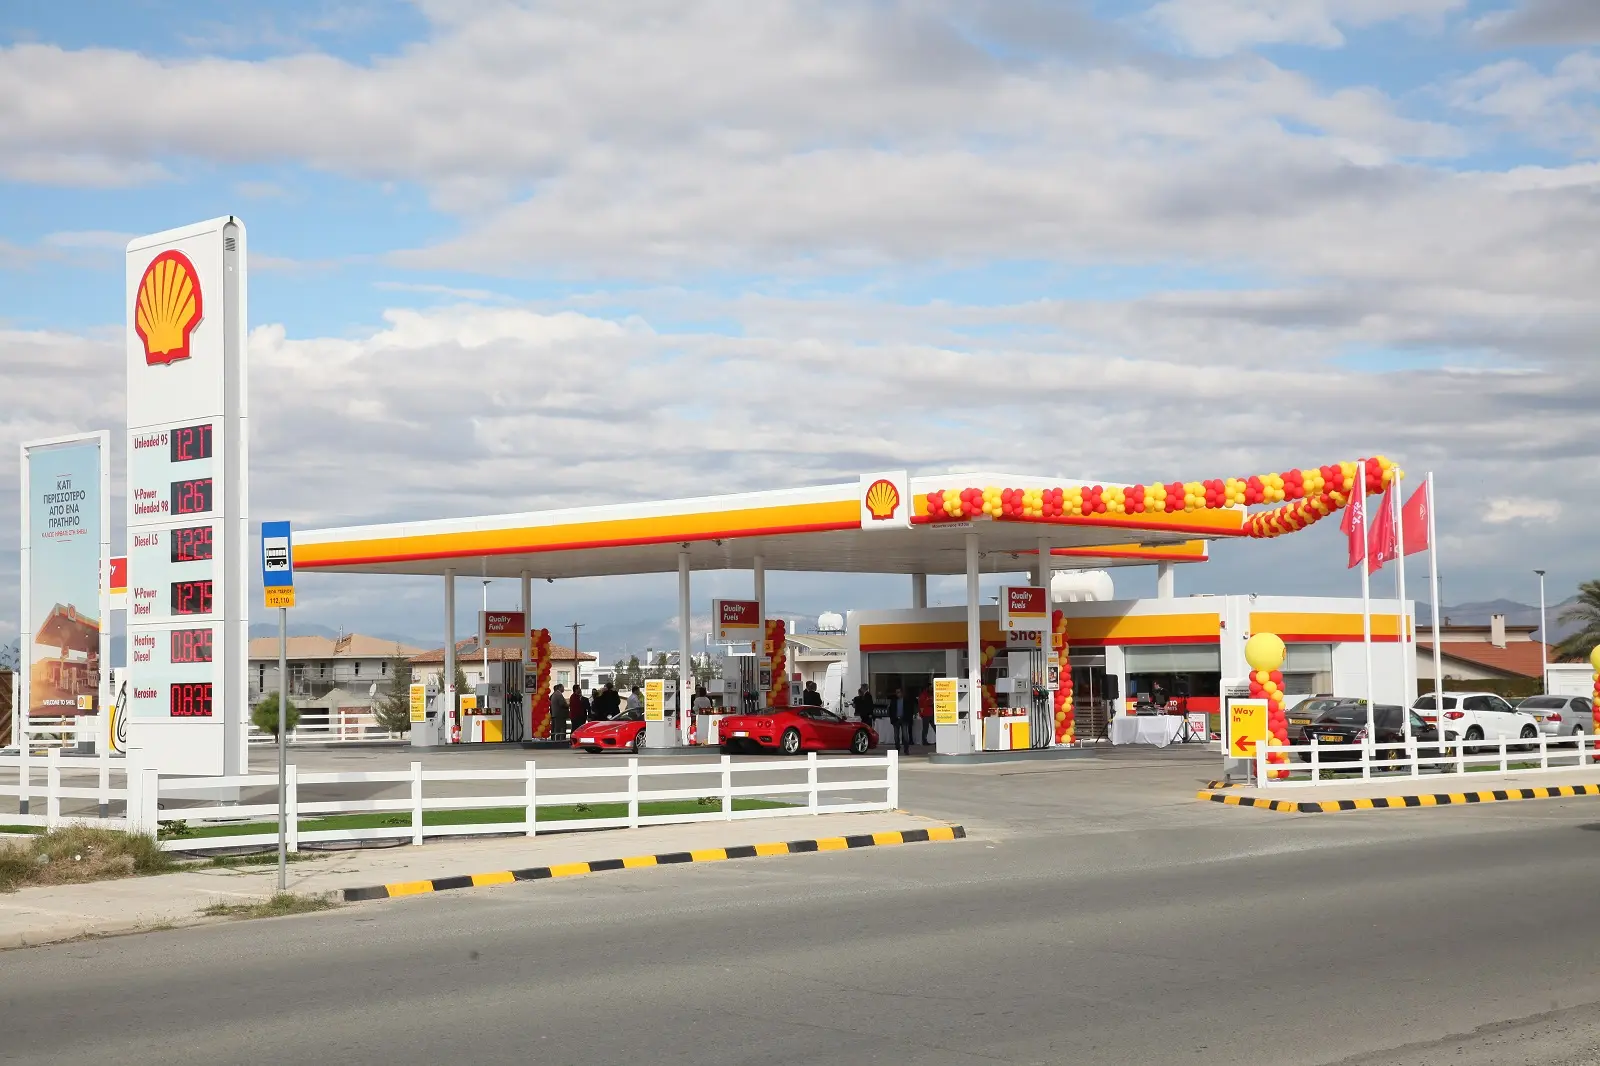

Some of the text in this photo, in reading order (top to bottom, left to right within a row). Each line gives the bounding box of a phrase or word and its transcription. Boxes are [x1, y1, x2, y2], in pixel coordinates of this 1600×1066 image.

[134, 433, 168, 449] Unleaded 95
[57, 479, 71, 490] ΚΑΤΙ
[43, 490, 86, 504] ΠΕΡΙΣΣΟΤΕΡΟ
[134, 488, 157, 500] V-Power
[49, 504, 80, 516] ΑΠΟ ΕΝΑ
[134, 500, 169, 514] Unleaded 98
[48, 515, 80, 528] ΠΡΑΤΗΡΙΟ
[134, 533, 158, 547] Diesel LS
[134, 587, 157, 599] V-Power
[1011, 592, 1033, 602] Quality
[134, 604, 151, 615] Diesel
[723, 604, 746, 615] Quality
[488, 615, 511, 624] Quality
[723, 613, 739, 621] Fuels
[488, 623, 504, 631] Fuels
[134, 634, 156, 648] Heating
[1010, 630, 1042, 641] Sho
[134, 650, 151, 662] Diesel
[134, 687, 157, 699] Kerosine
[1233, 707, 1255, 716] Way
